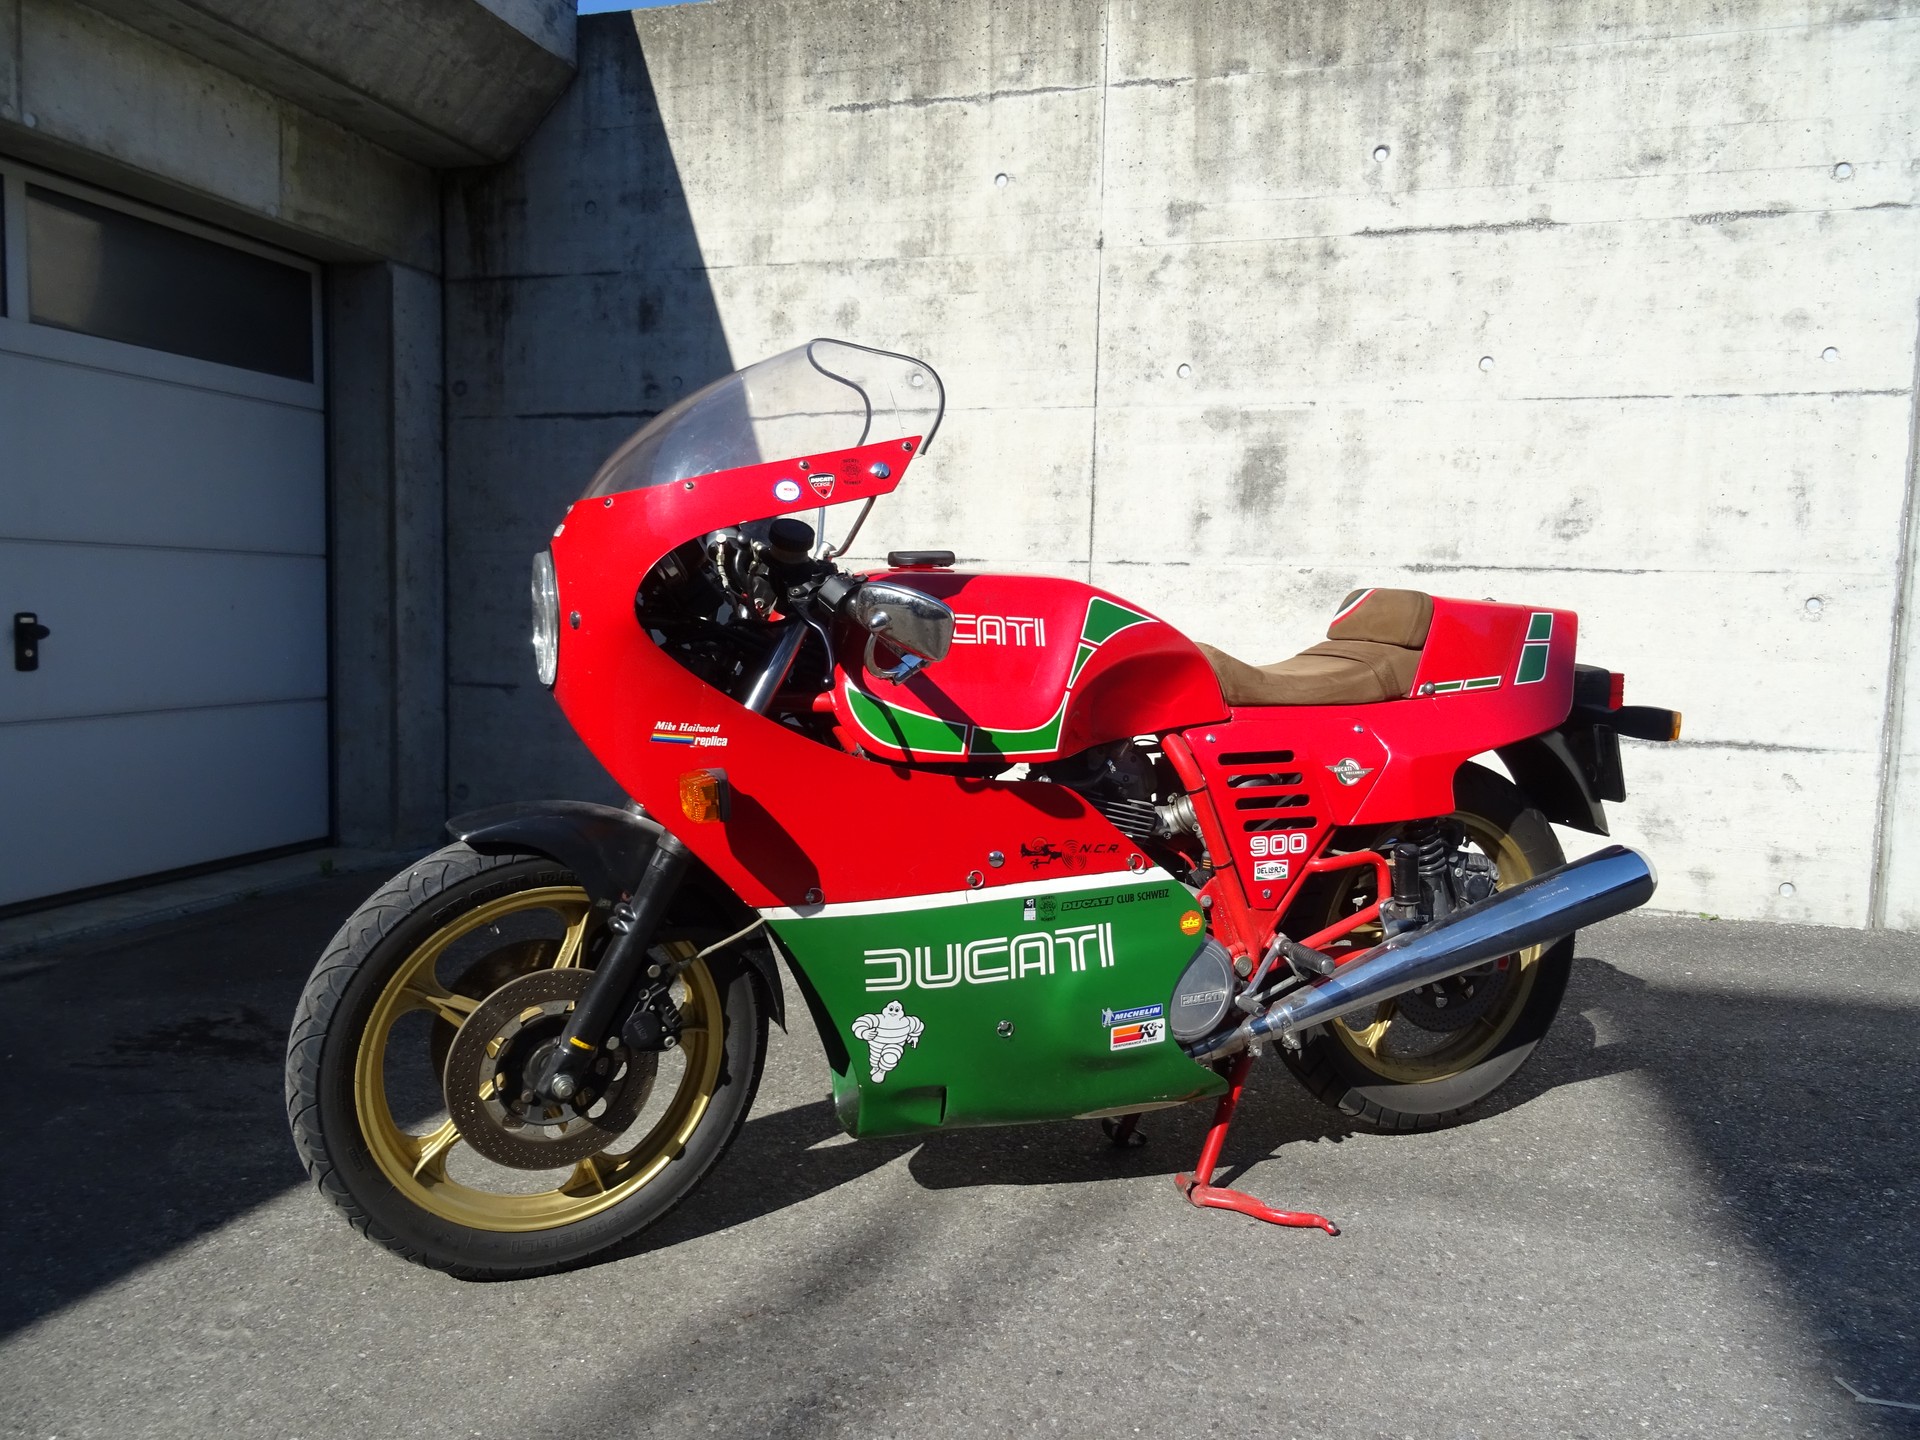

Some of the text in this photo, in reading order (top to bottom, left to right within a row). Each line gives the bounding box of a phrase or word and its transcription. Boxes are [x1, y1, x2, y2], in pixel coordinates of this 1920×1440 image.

[951, 613, 1046, 647] CATI
[654, 720, 721, 733] Mike Hailwood
[694, 735, 728, 747] replica
[1250, 832, 1307, 857] 900
[1061, 888, 1170, 911] DUCATI CLUB SCHWEIZ
[1181, 916, 1200, 930] sbs
[864, 922, 1115, 992] DUCATI
[1181, 990, 1225, 1007] DUCATI
[1114, 1006, 1161, 1020] MICHELIN
[1112, 1040, 1142, 1049] PERFORMANCE
